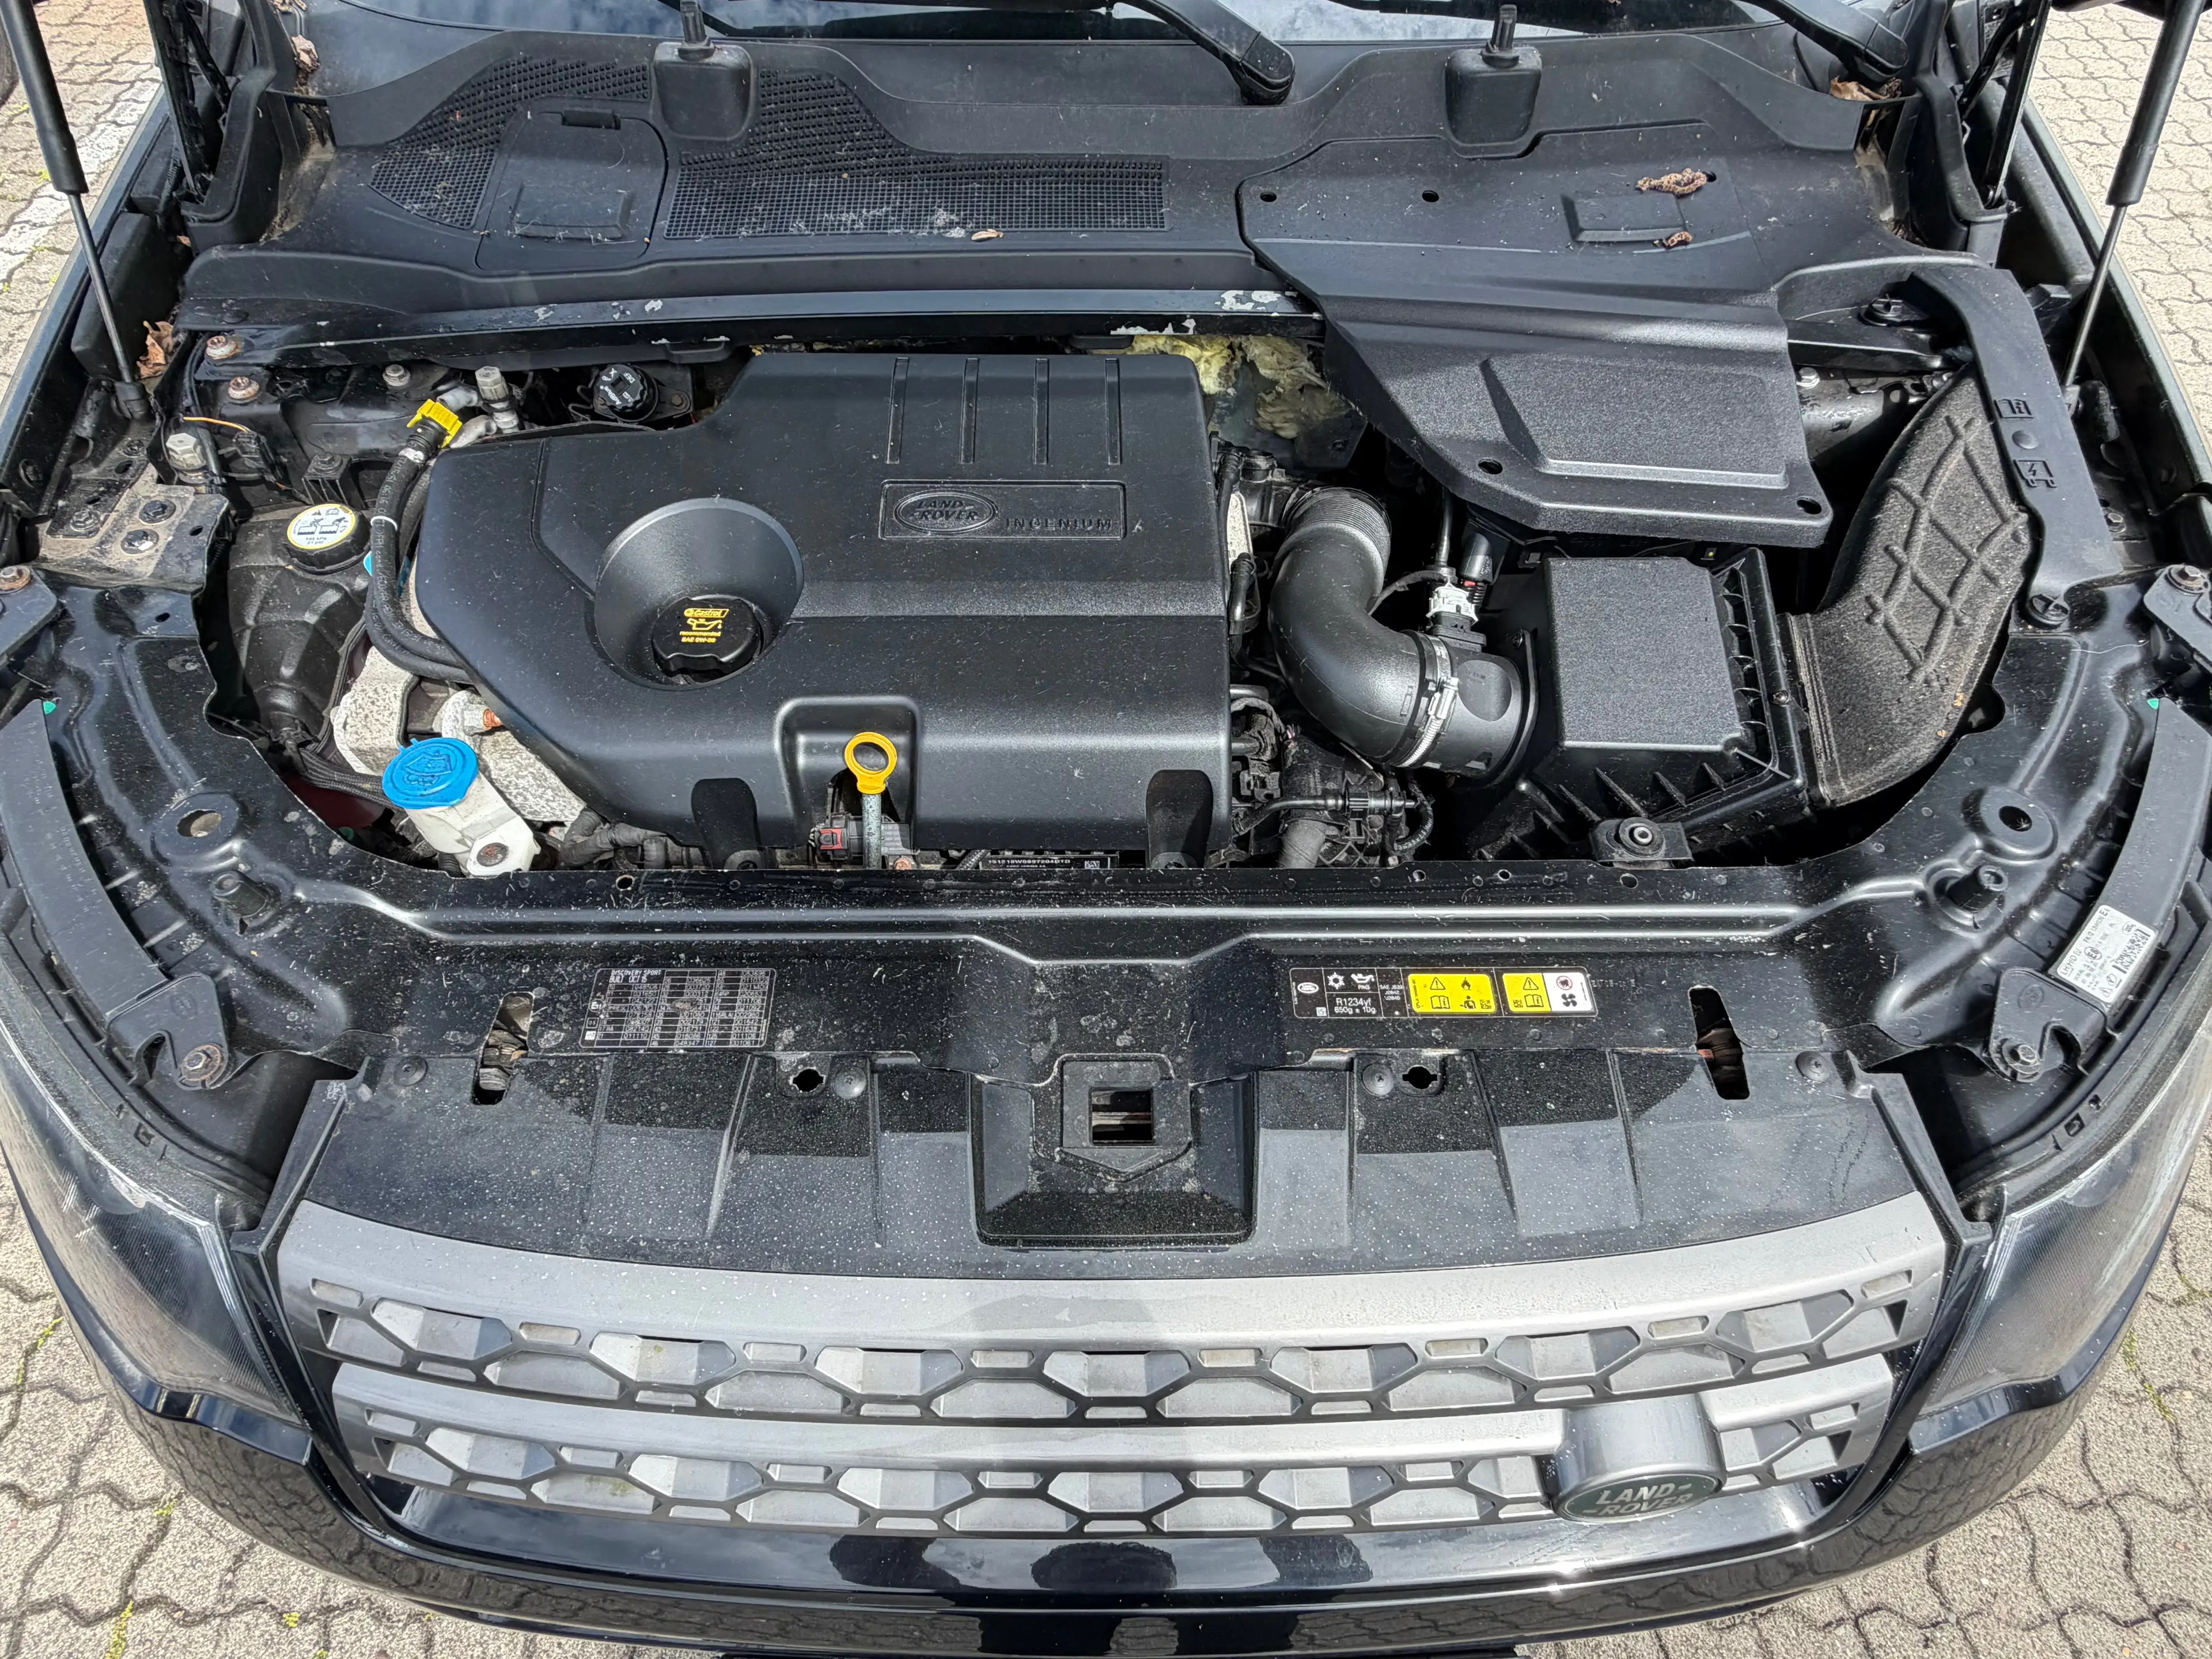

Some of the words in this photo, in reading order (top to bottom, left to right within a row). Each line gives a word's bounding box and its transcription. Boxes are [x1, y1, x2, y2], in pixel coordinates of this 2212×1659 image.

[916, 500, 964, 509] LAND
[920, 510, 978, 521] ROVER
[1005, 518, 1113, 531] INGENIUM
[1336, 997, 1372, 1007] R1234yf
[1334, 1006, 1353, 1014] 650g
[1362, 1006, 1376, 1014] 10g
[1596, 1483, 1676, 1505] LAND
[1599, 1493, 1694, 1516] ROVER
